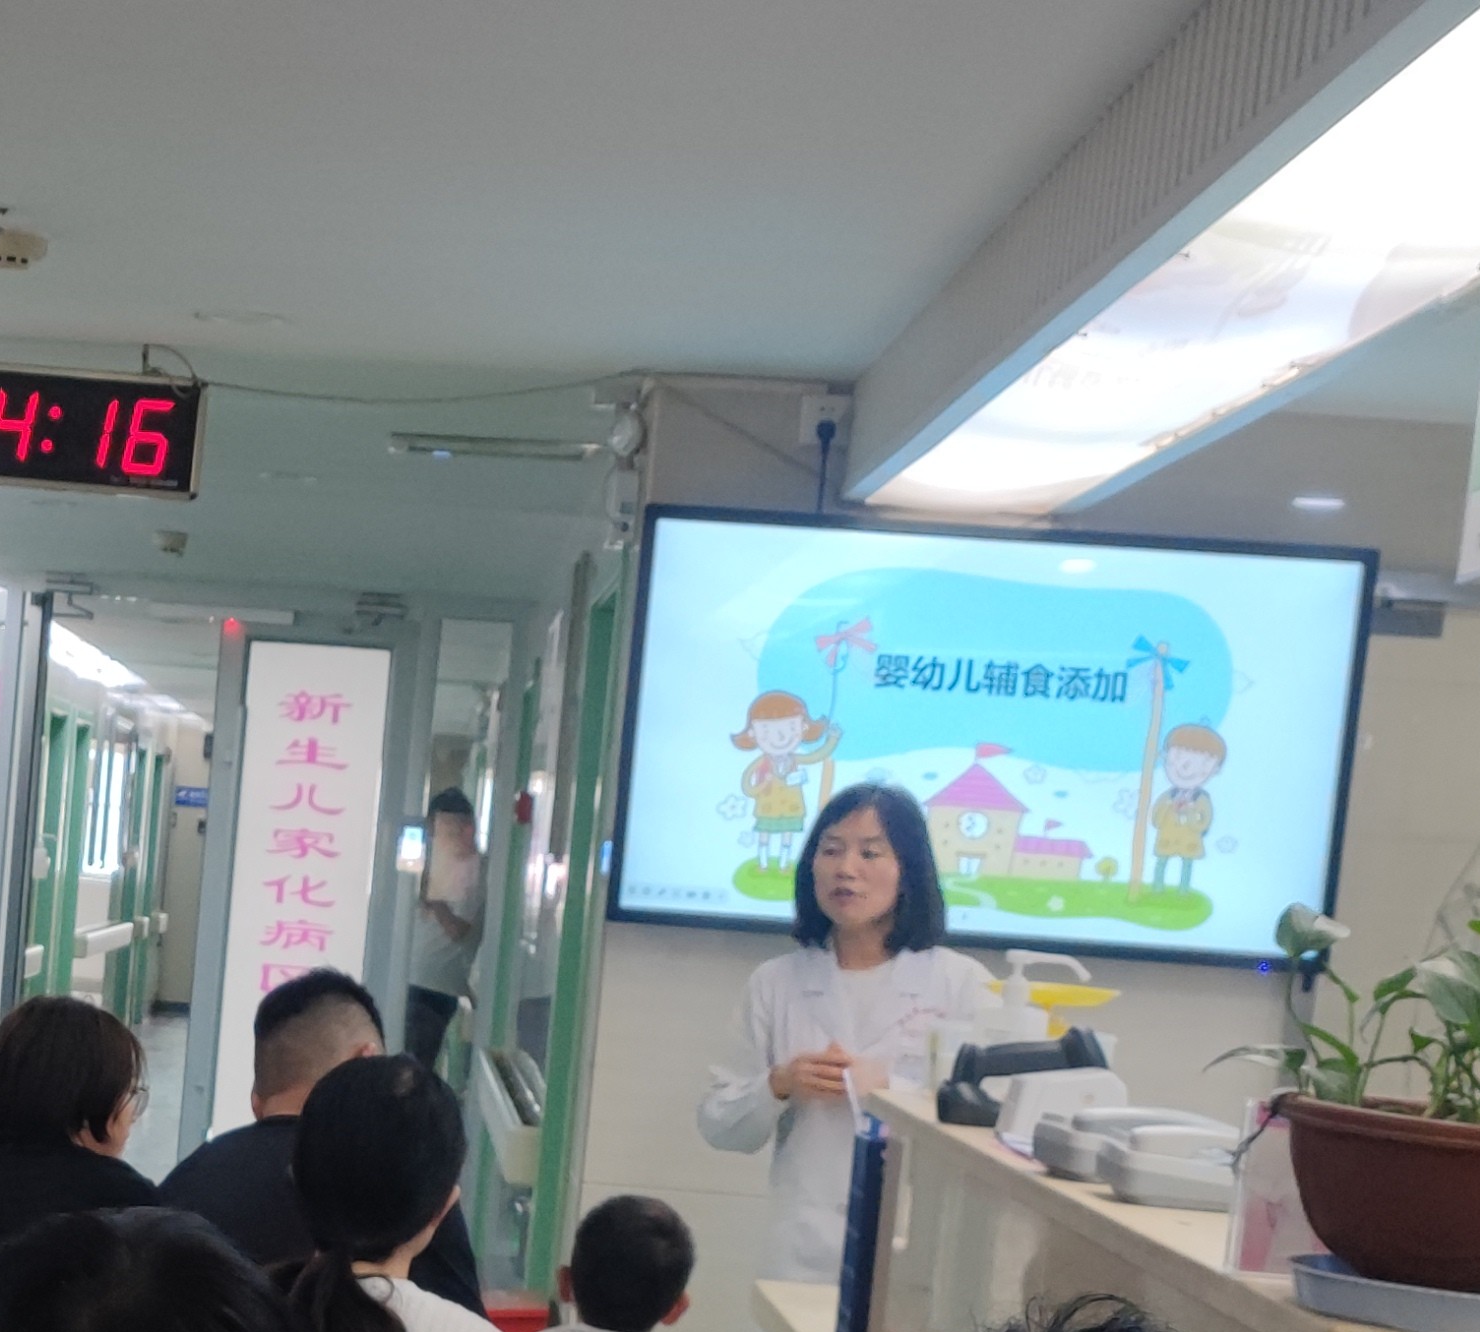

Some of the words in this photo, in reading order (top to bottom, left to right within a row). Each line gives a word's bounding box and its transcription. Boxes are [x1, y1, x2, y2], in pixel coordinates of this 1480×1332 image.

[874, 654, 1128, 703] 婴幼儿辅食添加
